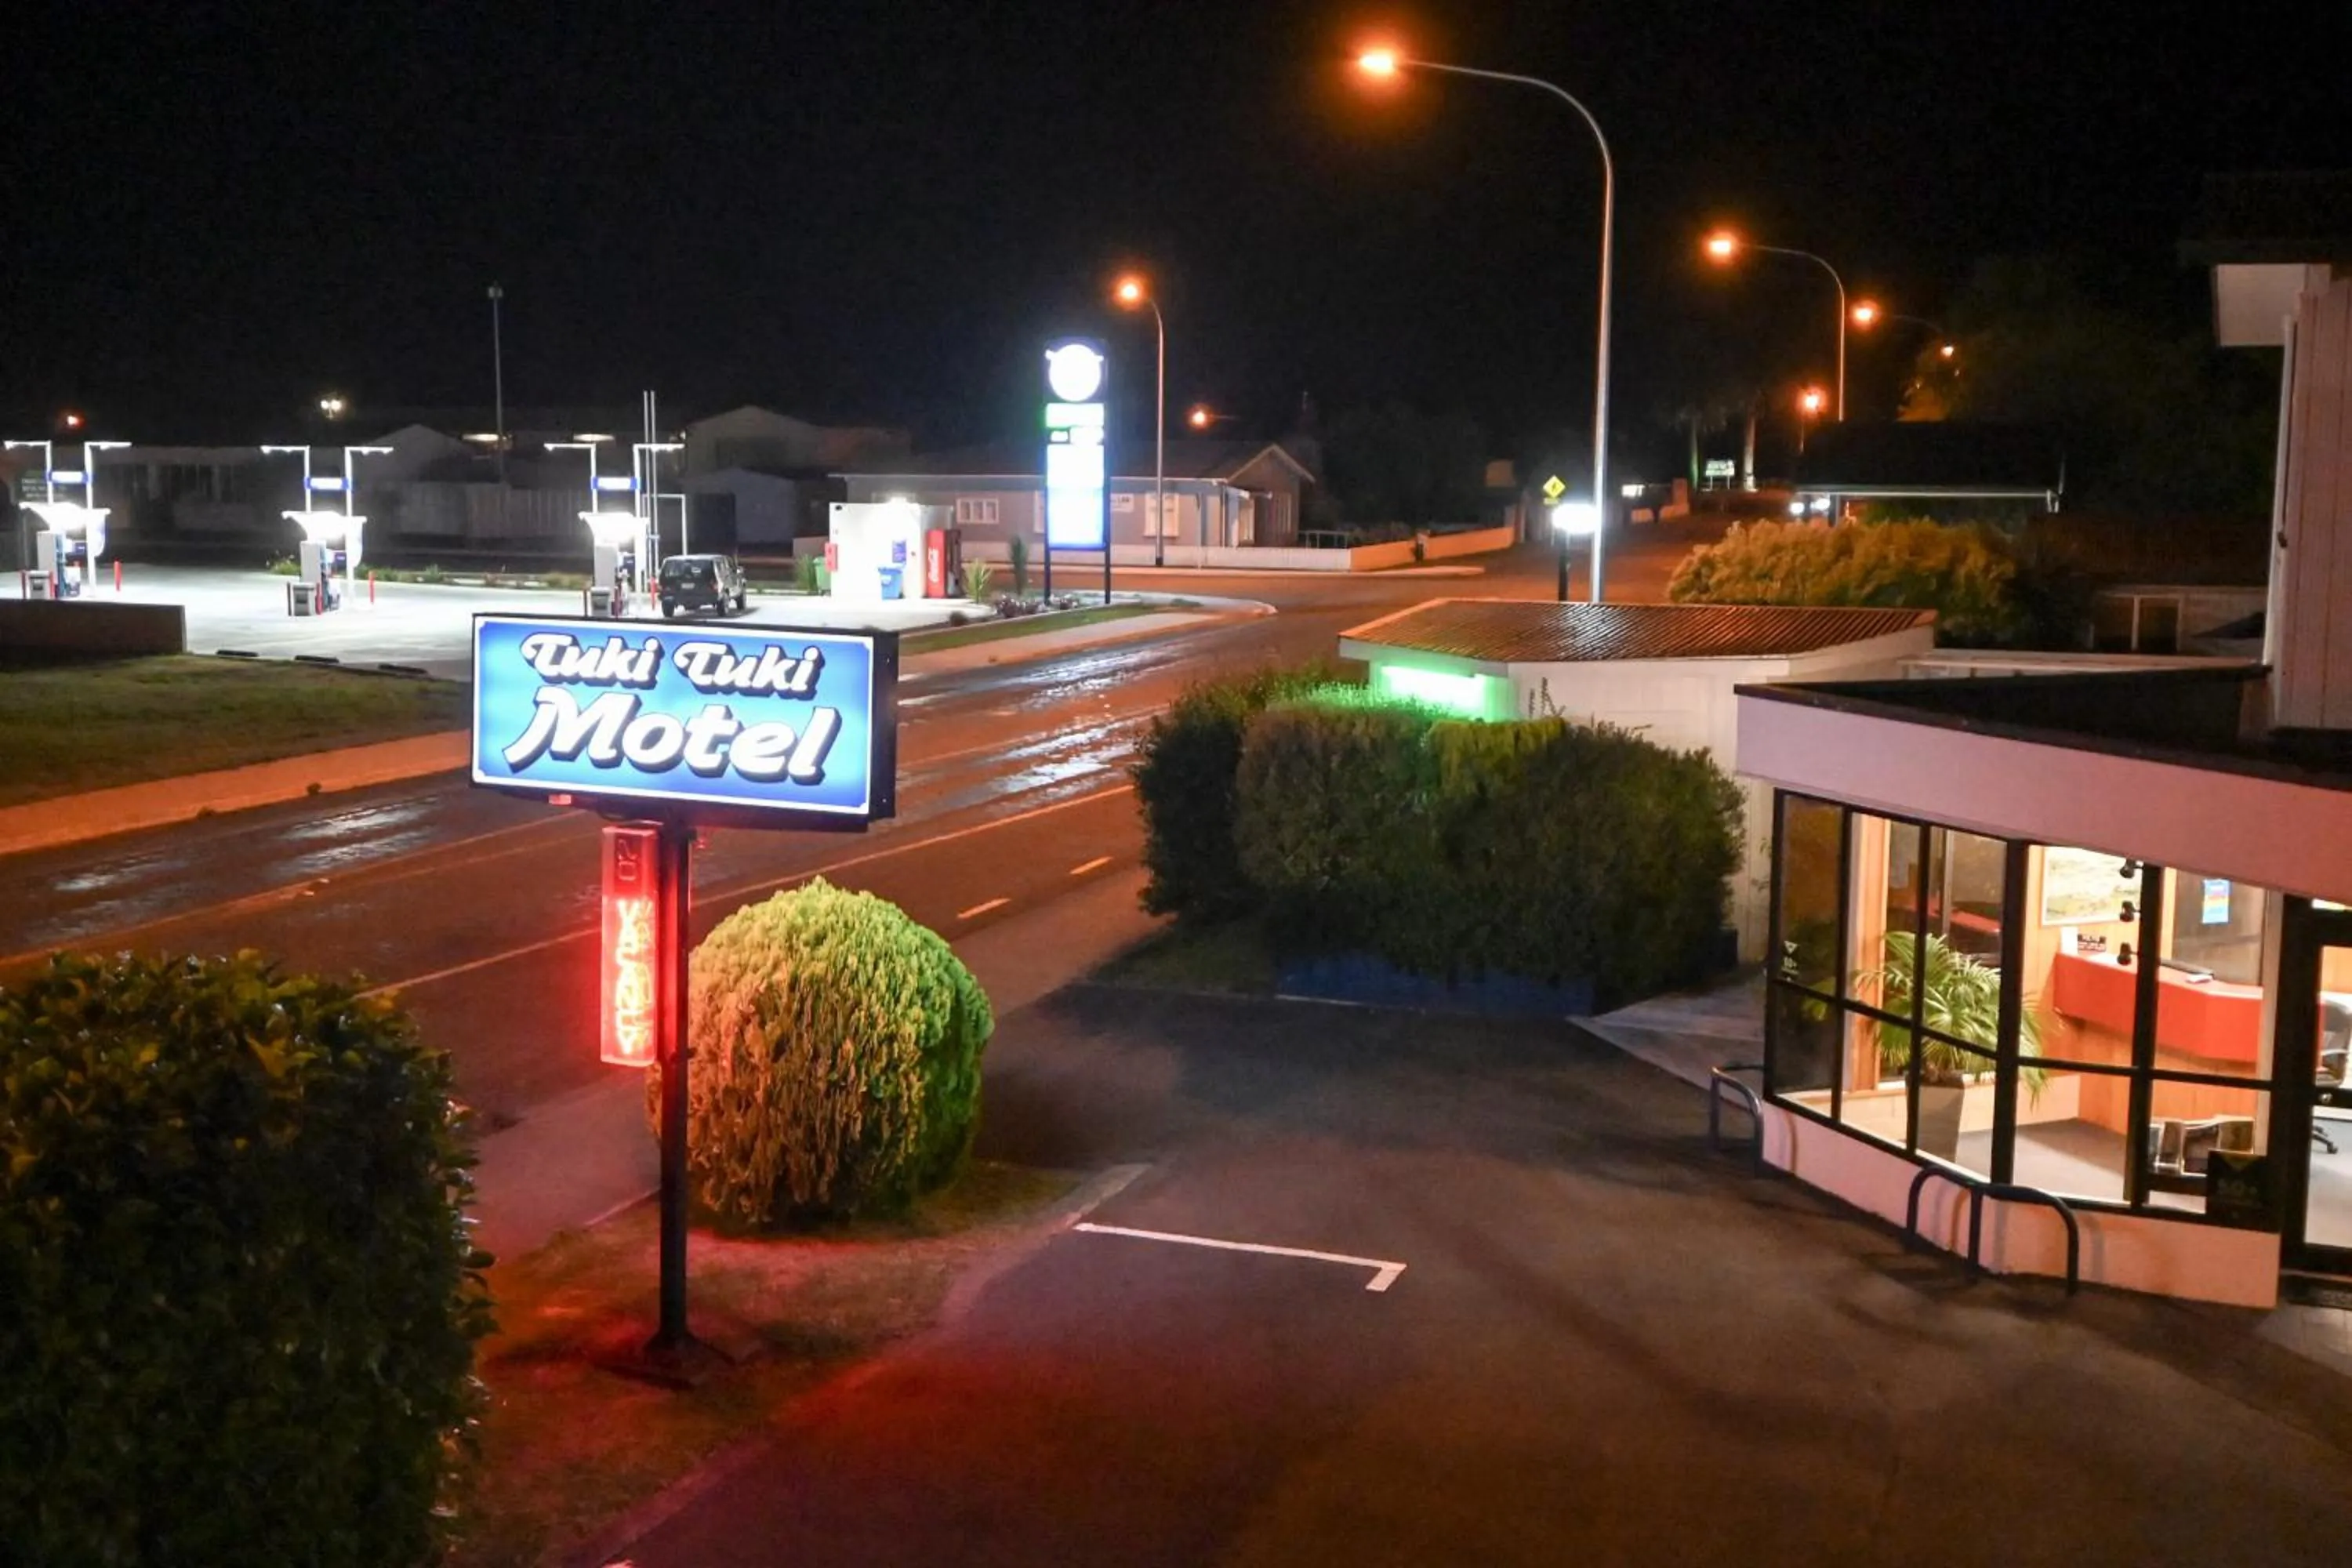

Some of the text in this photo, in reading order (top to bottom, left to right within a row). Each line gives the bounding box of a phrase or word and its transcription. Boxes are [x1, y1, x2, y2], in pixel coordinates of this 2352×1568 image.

[521, 632, 823, 699] Tuki Tuki
[503, 685, 842, 785] Motel
